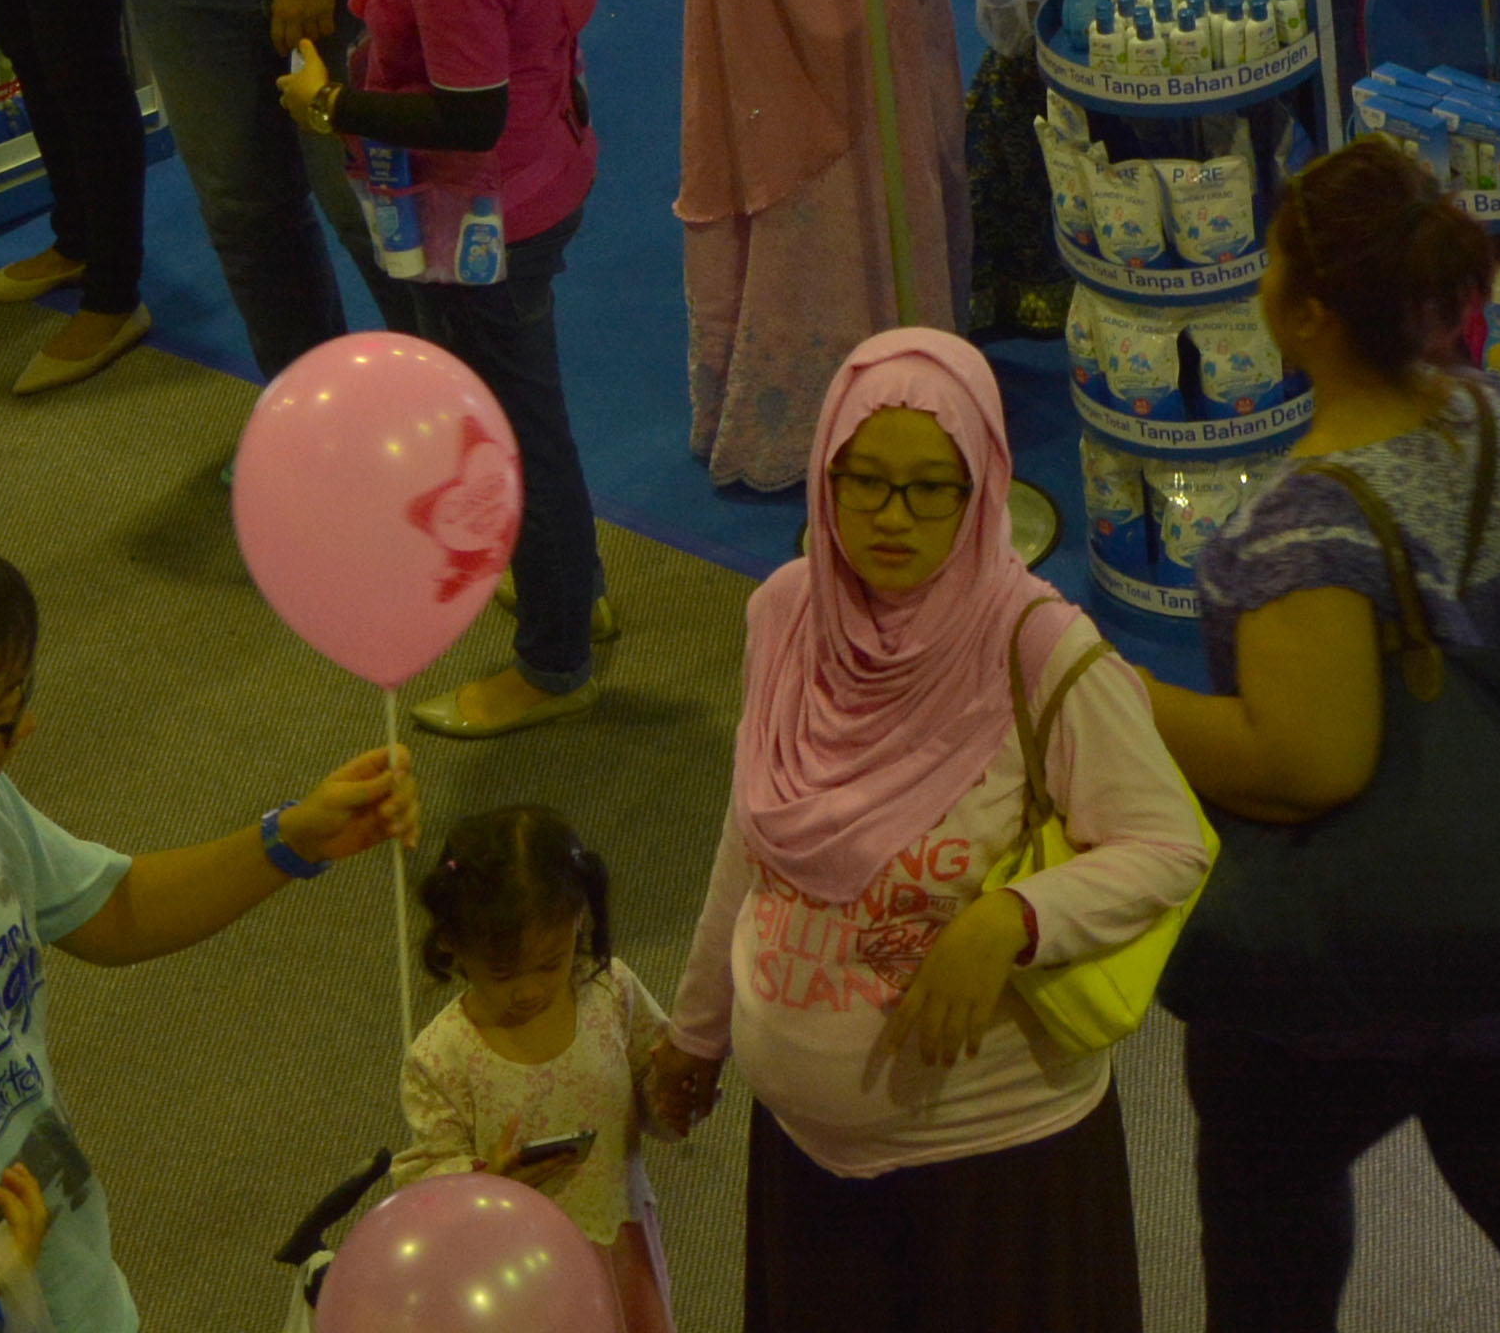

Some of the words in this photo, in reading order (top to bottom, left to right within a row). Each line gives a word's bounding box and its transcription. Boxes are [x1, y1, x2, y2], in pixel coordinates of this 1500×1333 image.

[1100, 73, 1161, 99] Tanpa
[1167, 72, 1234, 97] Bahan
[1238, 44, 1309, 85] Deterjen
[1123, 270, 1184, 292] Tanpa
[1190, 264, 1257, 287] Bahan
[1136, 421, 1197, 444] Tanpa
[1203, 418, 1268, 442] Bahan
